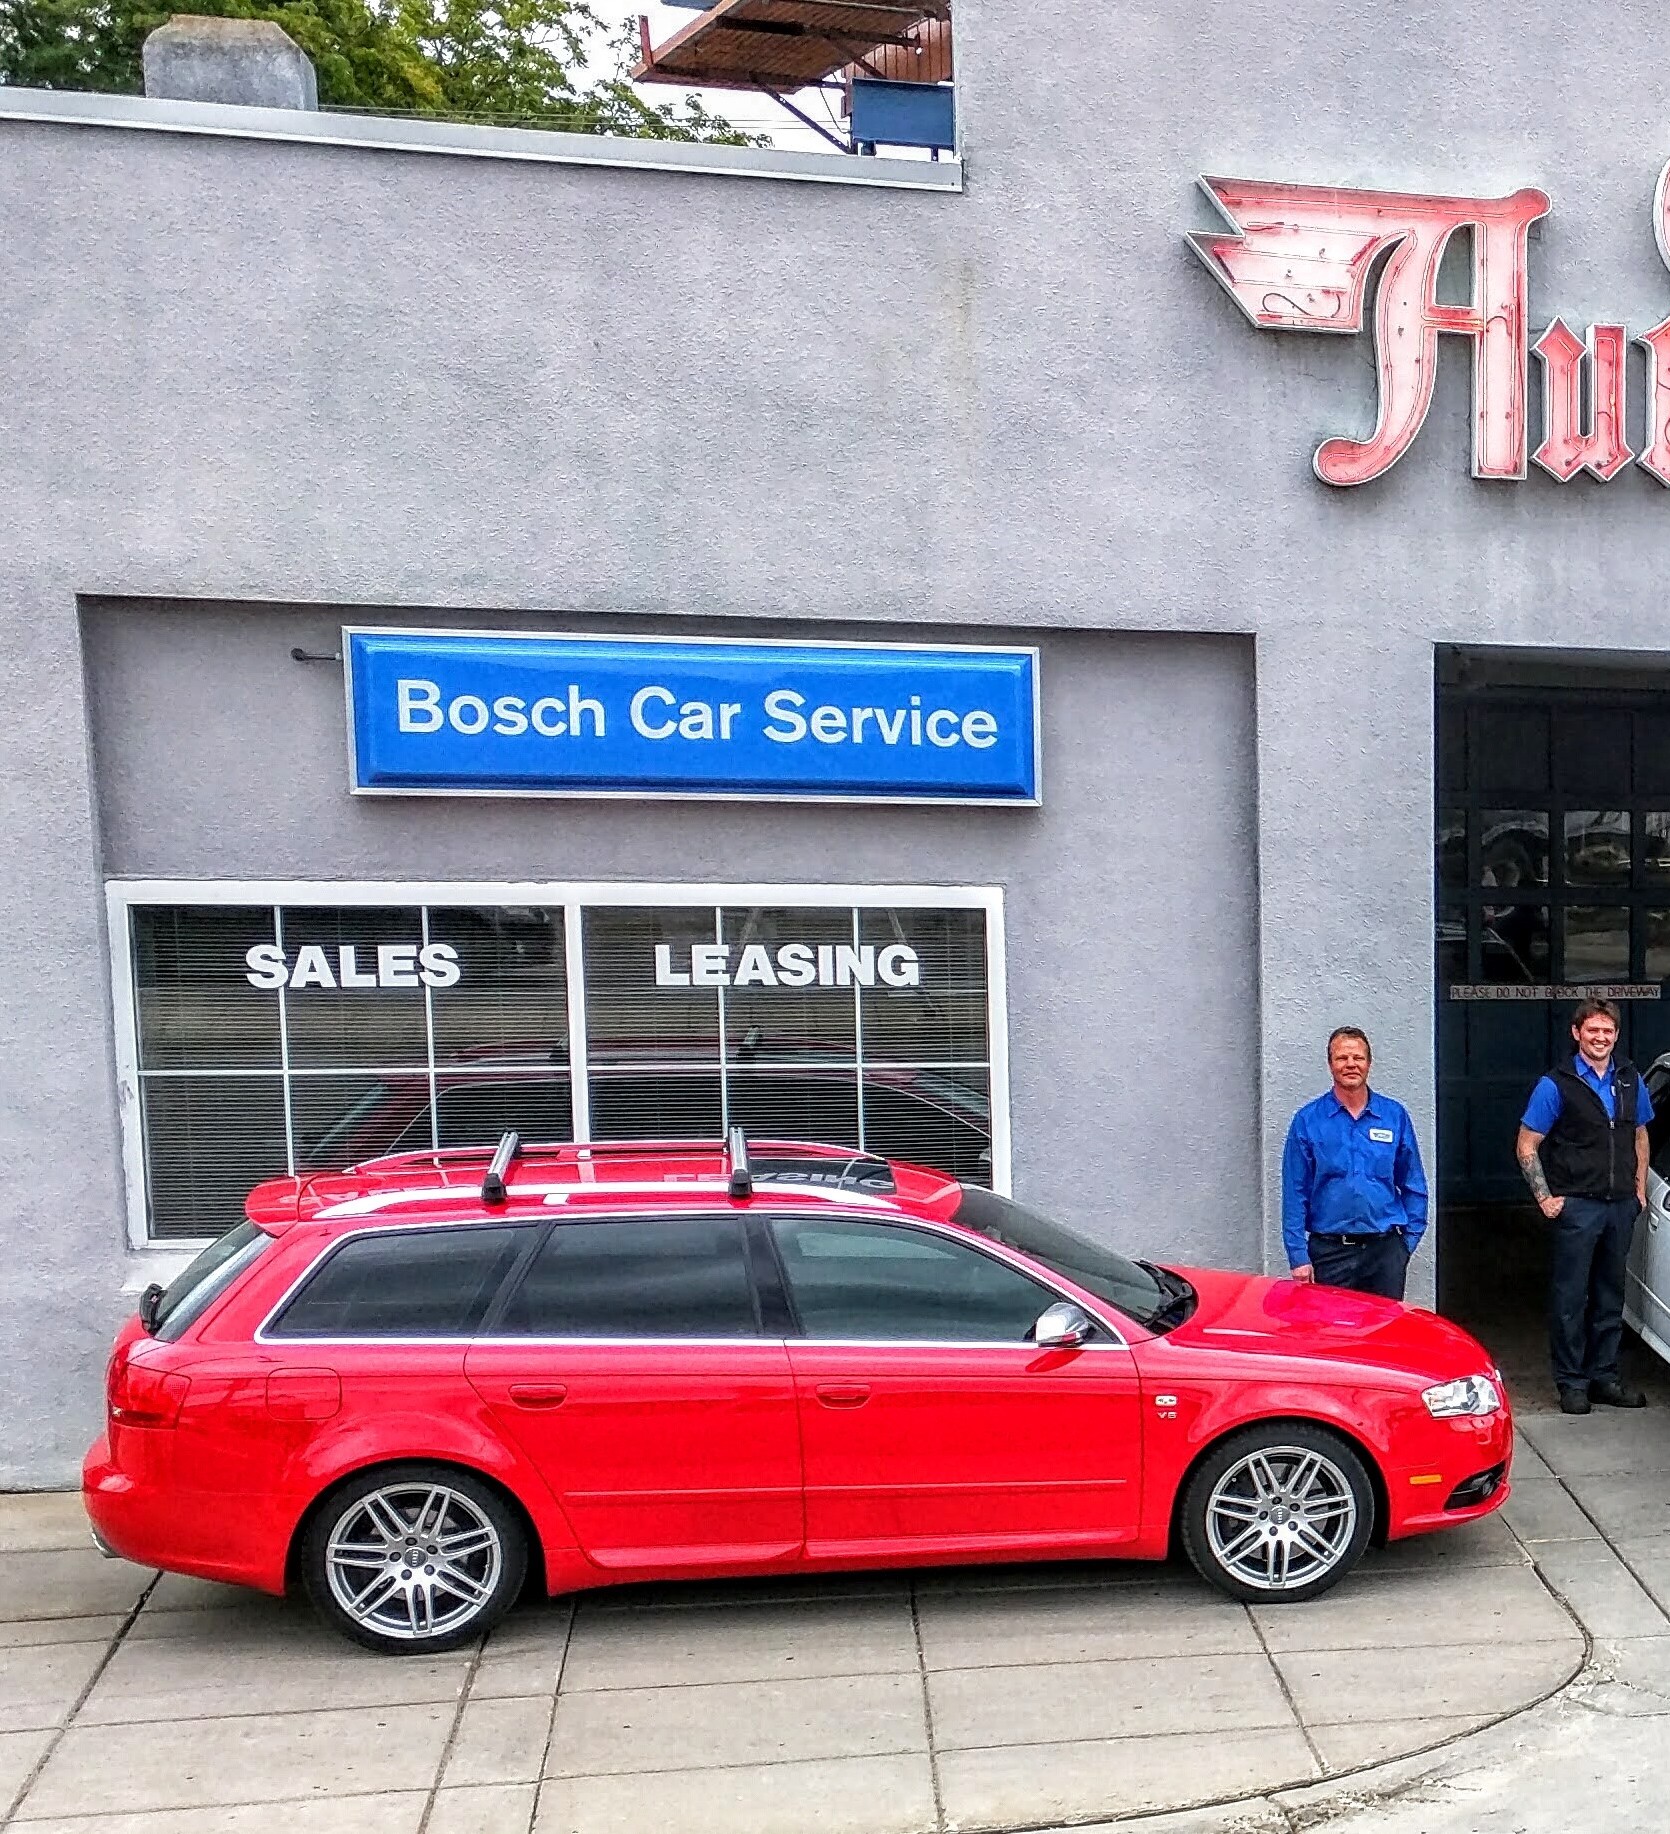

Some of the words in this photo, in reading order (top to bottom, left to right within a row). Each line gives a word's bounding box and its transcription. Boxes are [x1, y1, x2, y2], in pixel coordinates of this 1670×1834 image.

[397, 678, 606, 738] Bosch
[630, 685, 742, 742] Car
[762, 689, 998, 749] Service
[245, 944, 461, 989] SALES
[654, 944, 920, 988] LEASING
[1452, 986, 1491, 999] PLEASE
[1496, 986, 1511, 998] DO
[1515, 986, 1539, 998] NOT
[1607, 985, 1660, 998] DRIVEWAY
